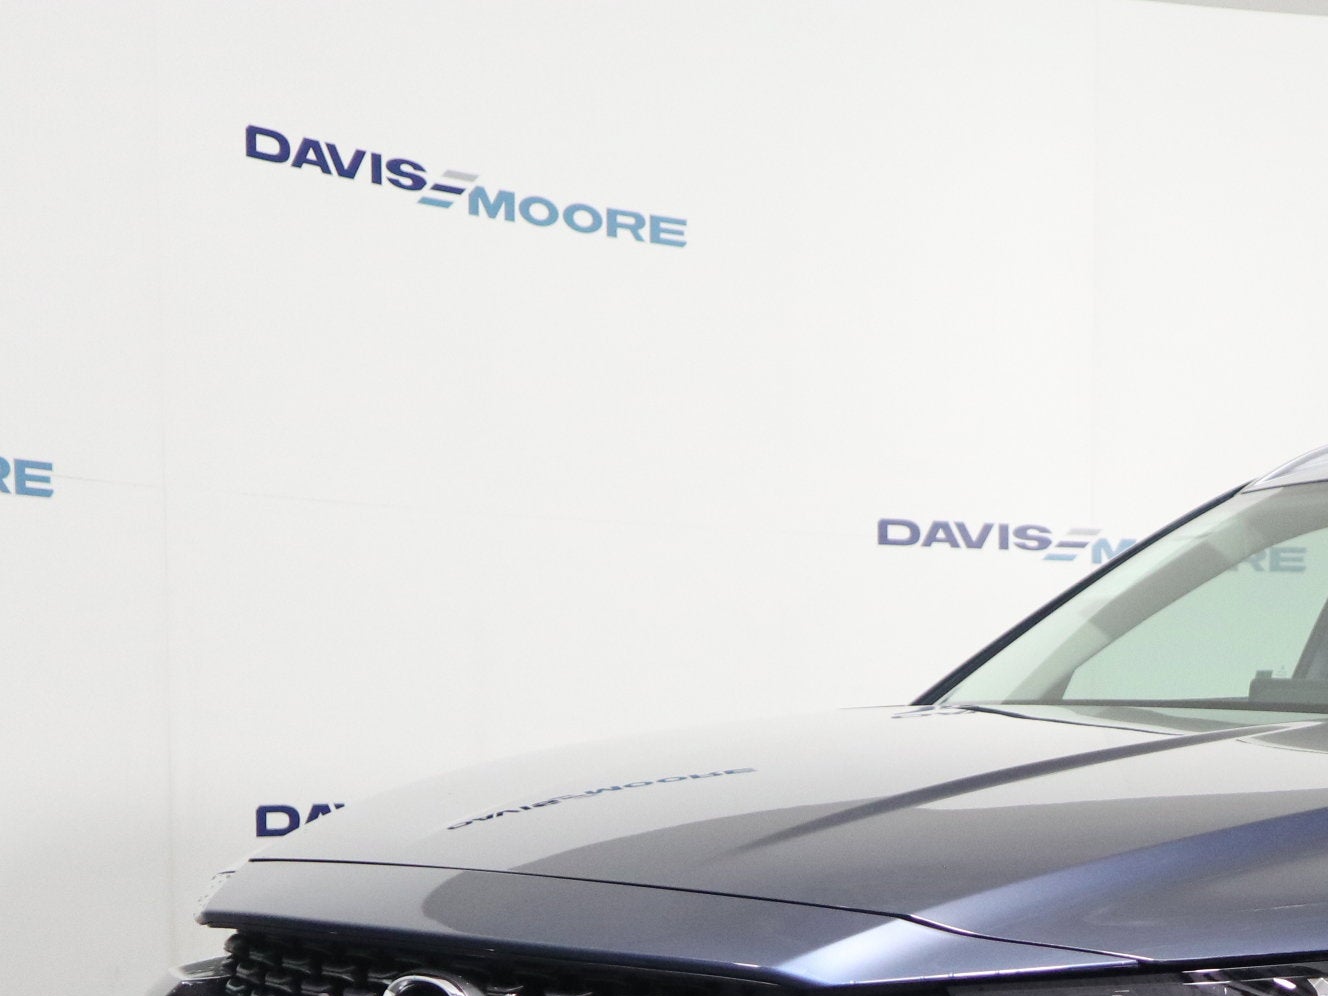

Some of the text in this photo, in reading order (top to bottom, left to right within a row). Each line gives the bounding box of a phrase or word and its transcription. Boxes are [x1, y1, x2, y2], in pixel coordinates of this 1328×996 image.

[245, 124, 688, 248] DAVIS MOORE
[877, 518, 1053, 551] DAVIS
